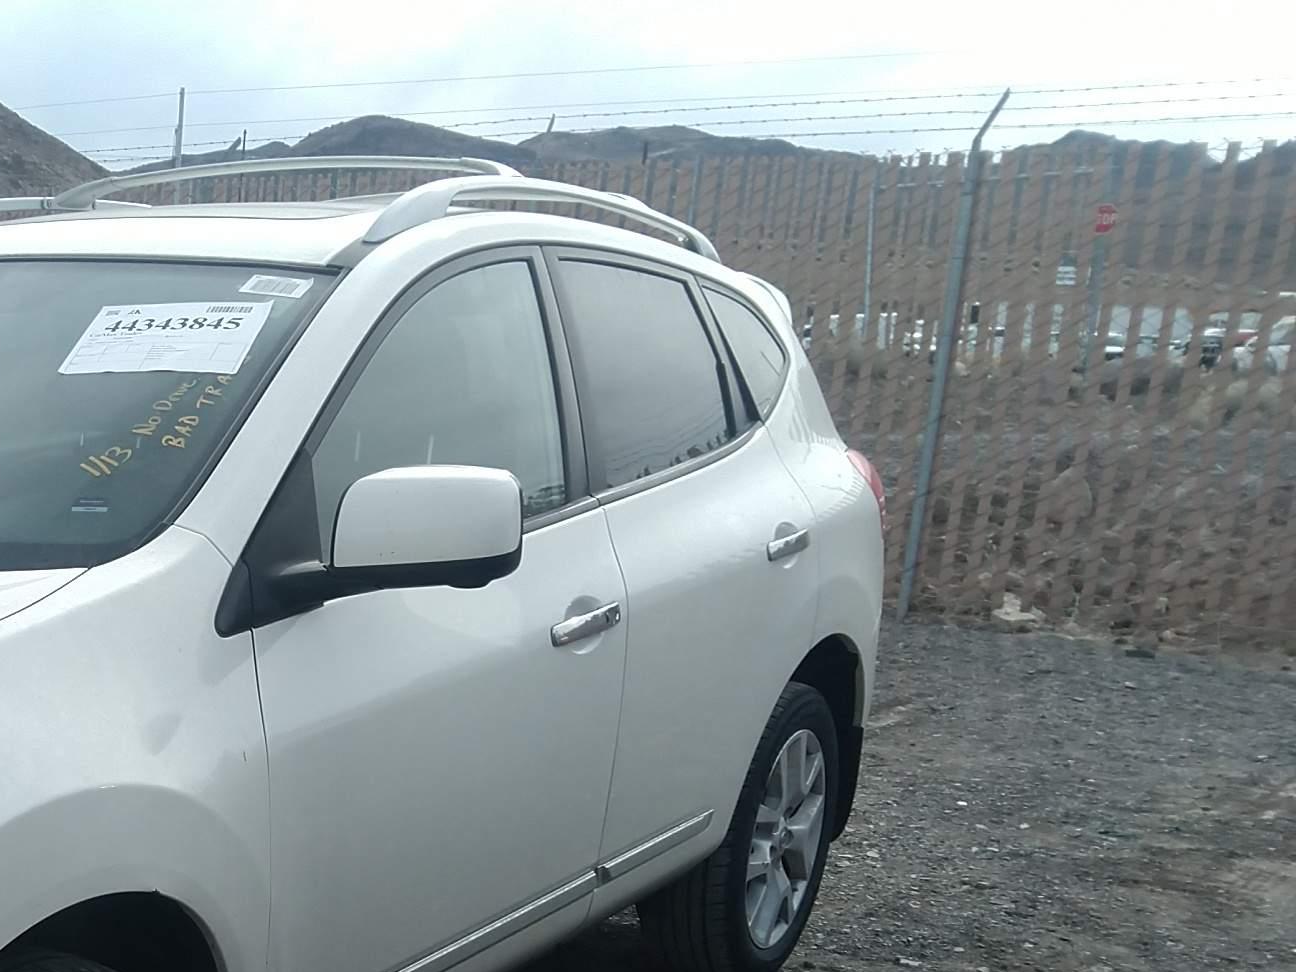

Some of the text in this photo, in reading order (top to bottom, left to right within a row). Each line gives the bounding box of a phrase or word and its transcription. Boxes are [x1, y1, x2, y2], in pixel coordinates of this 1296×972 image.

[105, 317, 243, 332] 44343845
[161, 375, 233, 449] BAD TRA
